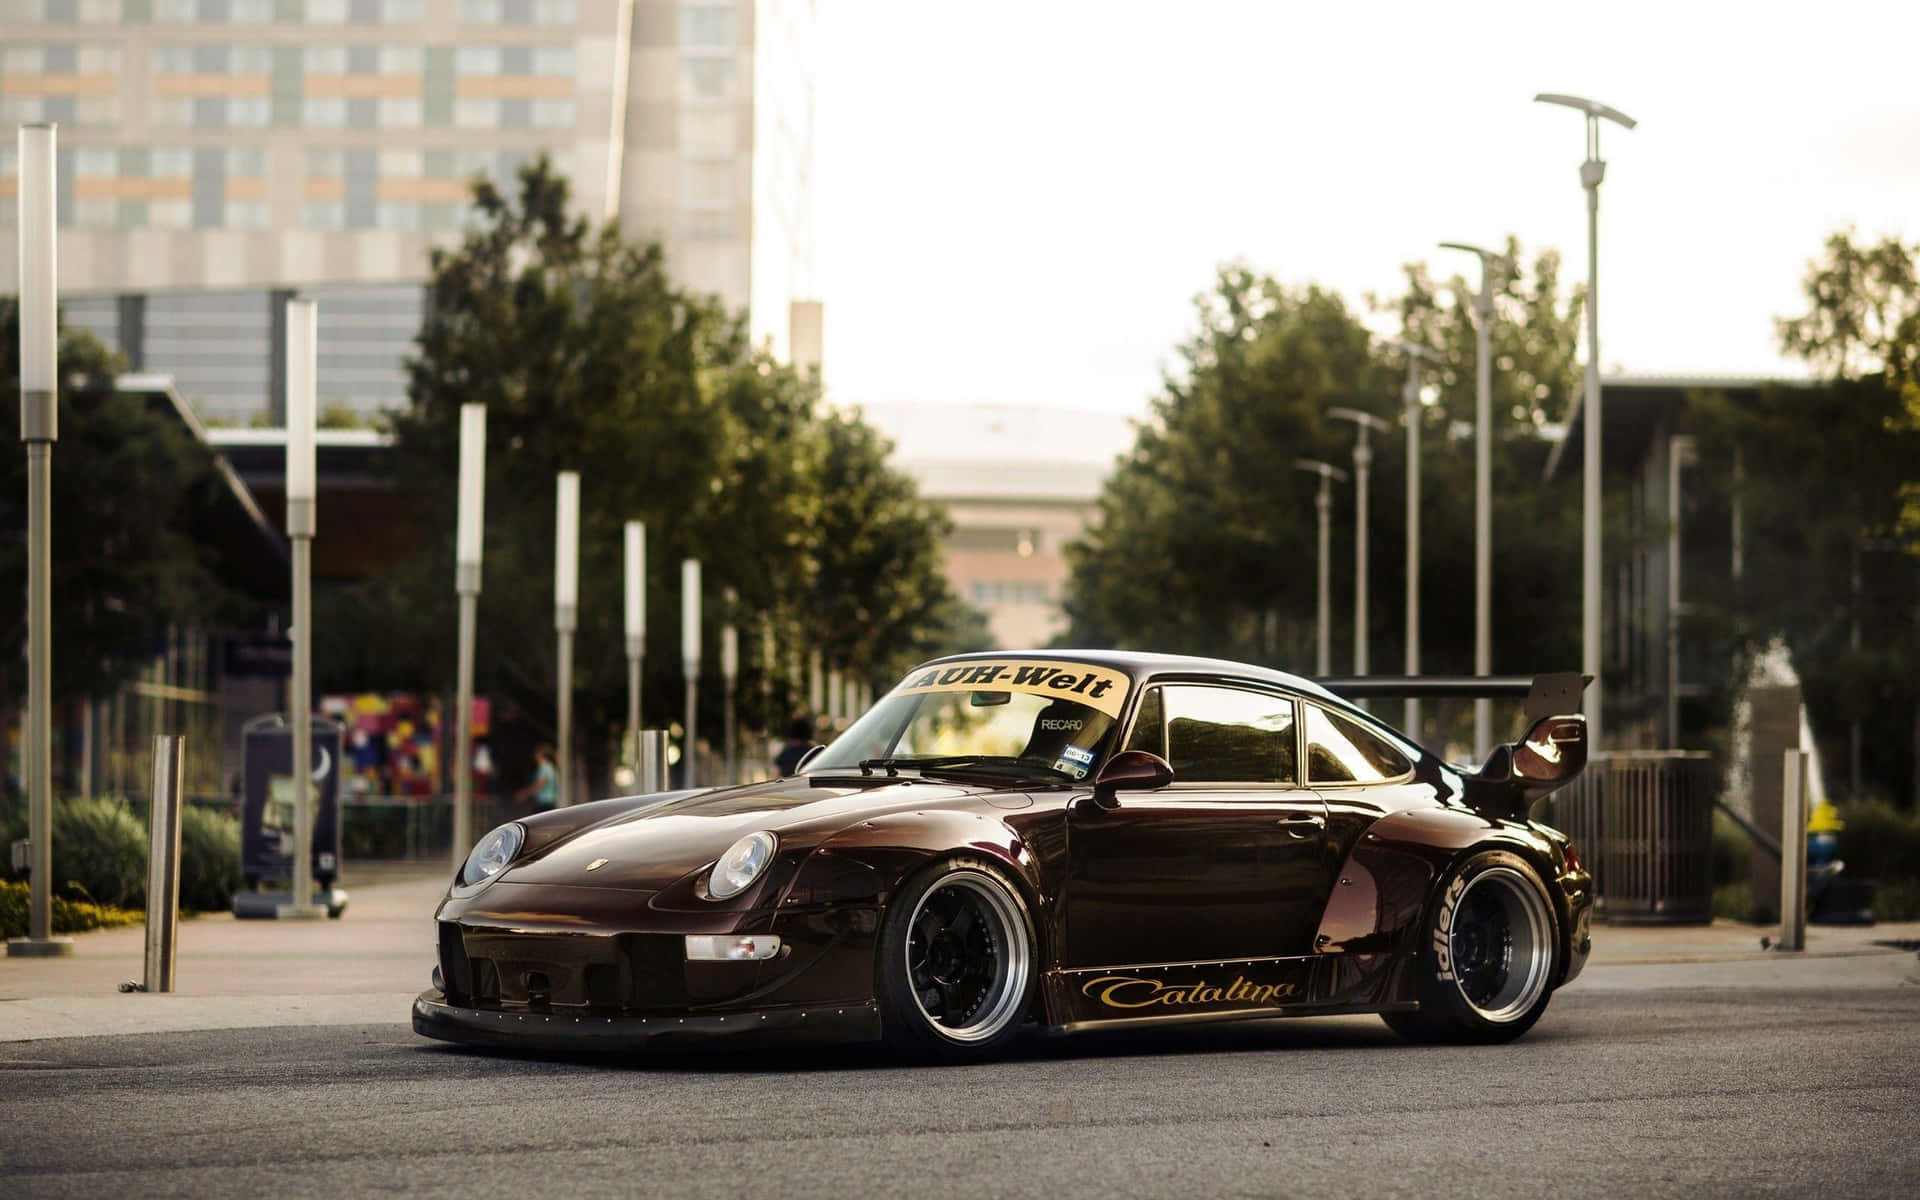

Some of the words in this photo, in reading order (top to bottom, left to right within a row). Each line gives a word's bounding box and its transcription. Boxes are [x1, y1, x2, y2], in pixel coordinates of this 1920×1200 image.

[907, 665, 1113, 698] AUH-Welt
[1041, 719, 1083, 730] RECARO
[1082, 975, 1296, 1009] Catalina
